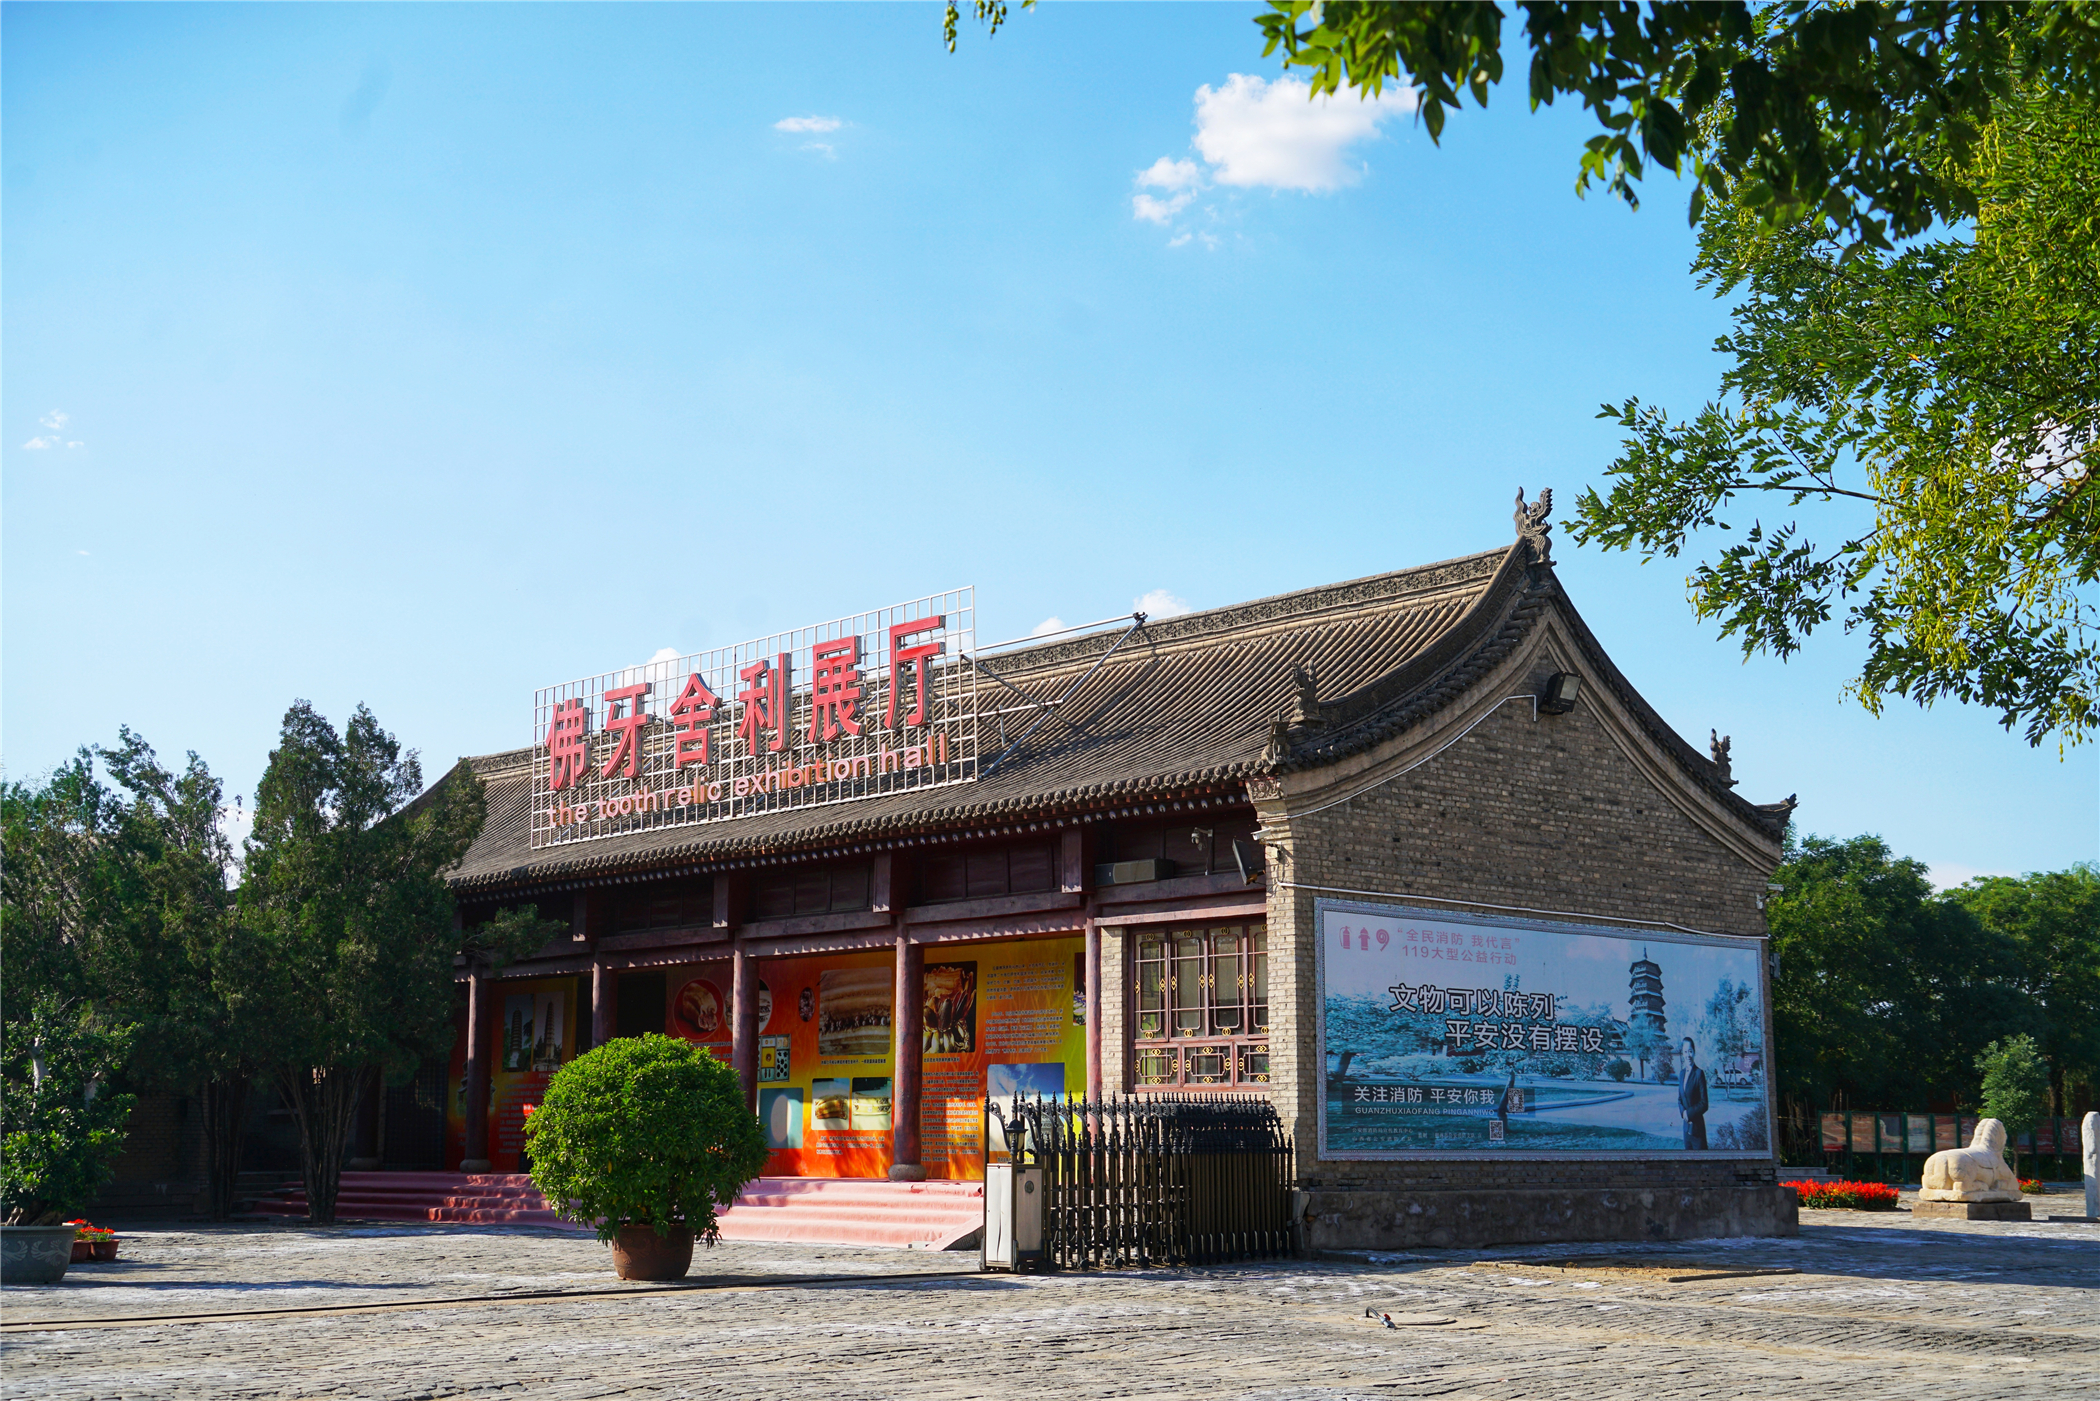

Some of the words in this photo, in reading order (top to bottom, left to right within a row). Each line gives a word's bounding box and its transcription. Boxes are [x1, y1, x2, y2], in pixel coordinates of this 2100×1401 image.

[546, 615, 945, 791] 佛牙舍利展厅
[547, 800, 589, 827] the
[597, 785, 659, 819] tooth
[664, 776, 722, 808] relic
[735, 753, 872, 796] exhibition
[881, 732, 948, 772] hall
[1402, 945, 1518, 966] 119大型公益行动
[1388, 982, 1555, 1020] 文物可以陈列
[1445, 1019, 1605, 1053] 平安没有摆设
[1354, 1086, 1423, 1103] 关注消防
[1430, 1087, 1495, 1105] 平安你我
[1355, 1106, 1440, 1115] GUANZHUXIAOFANG
[1442, 1108, 1495, 1116] PINGANNIWO
